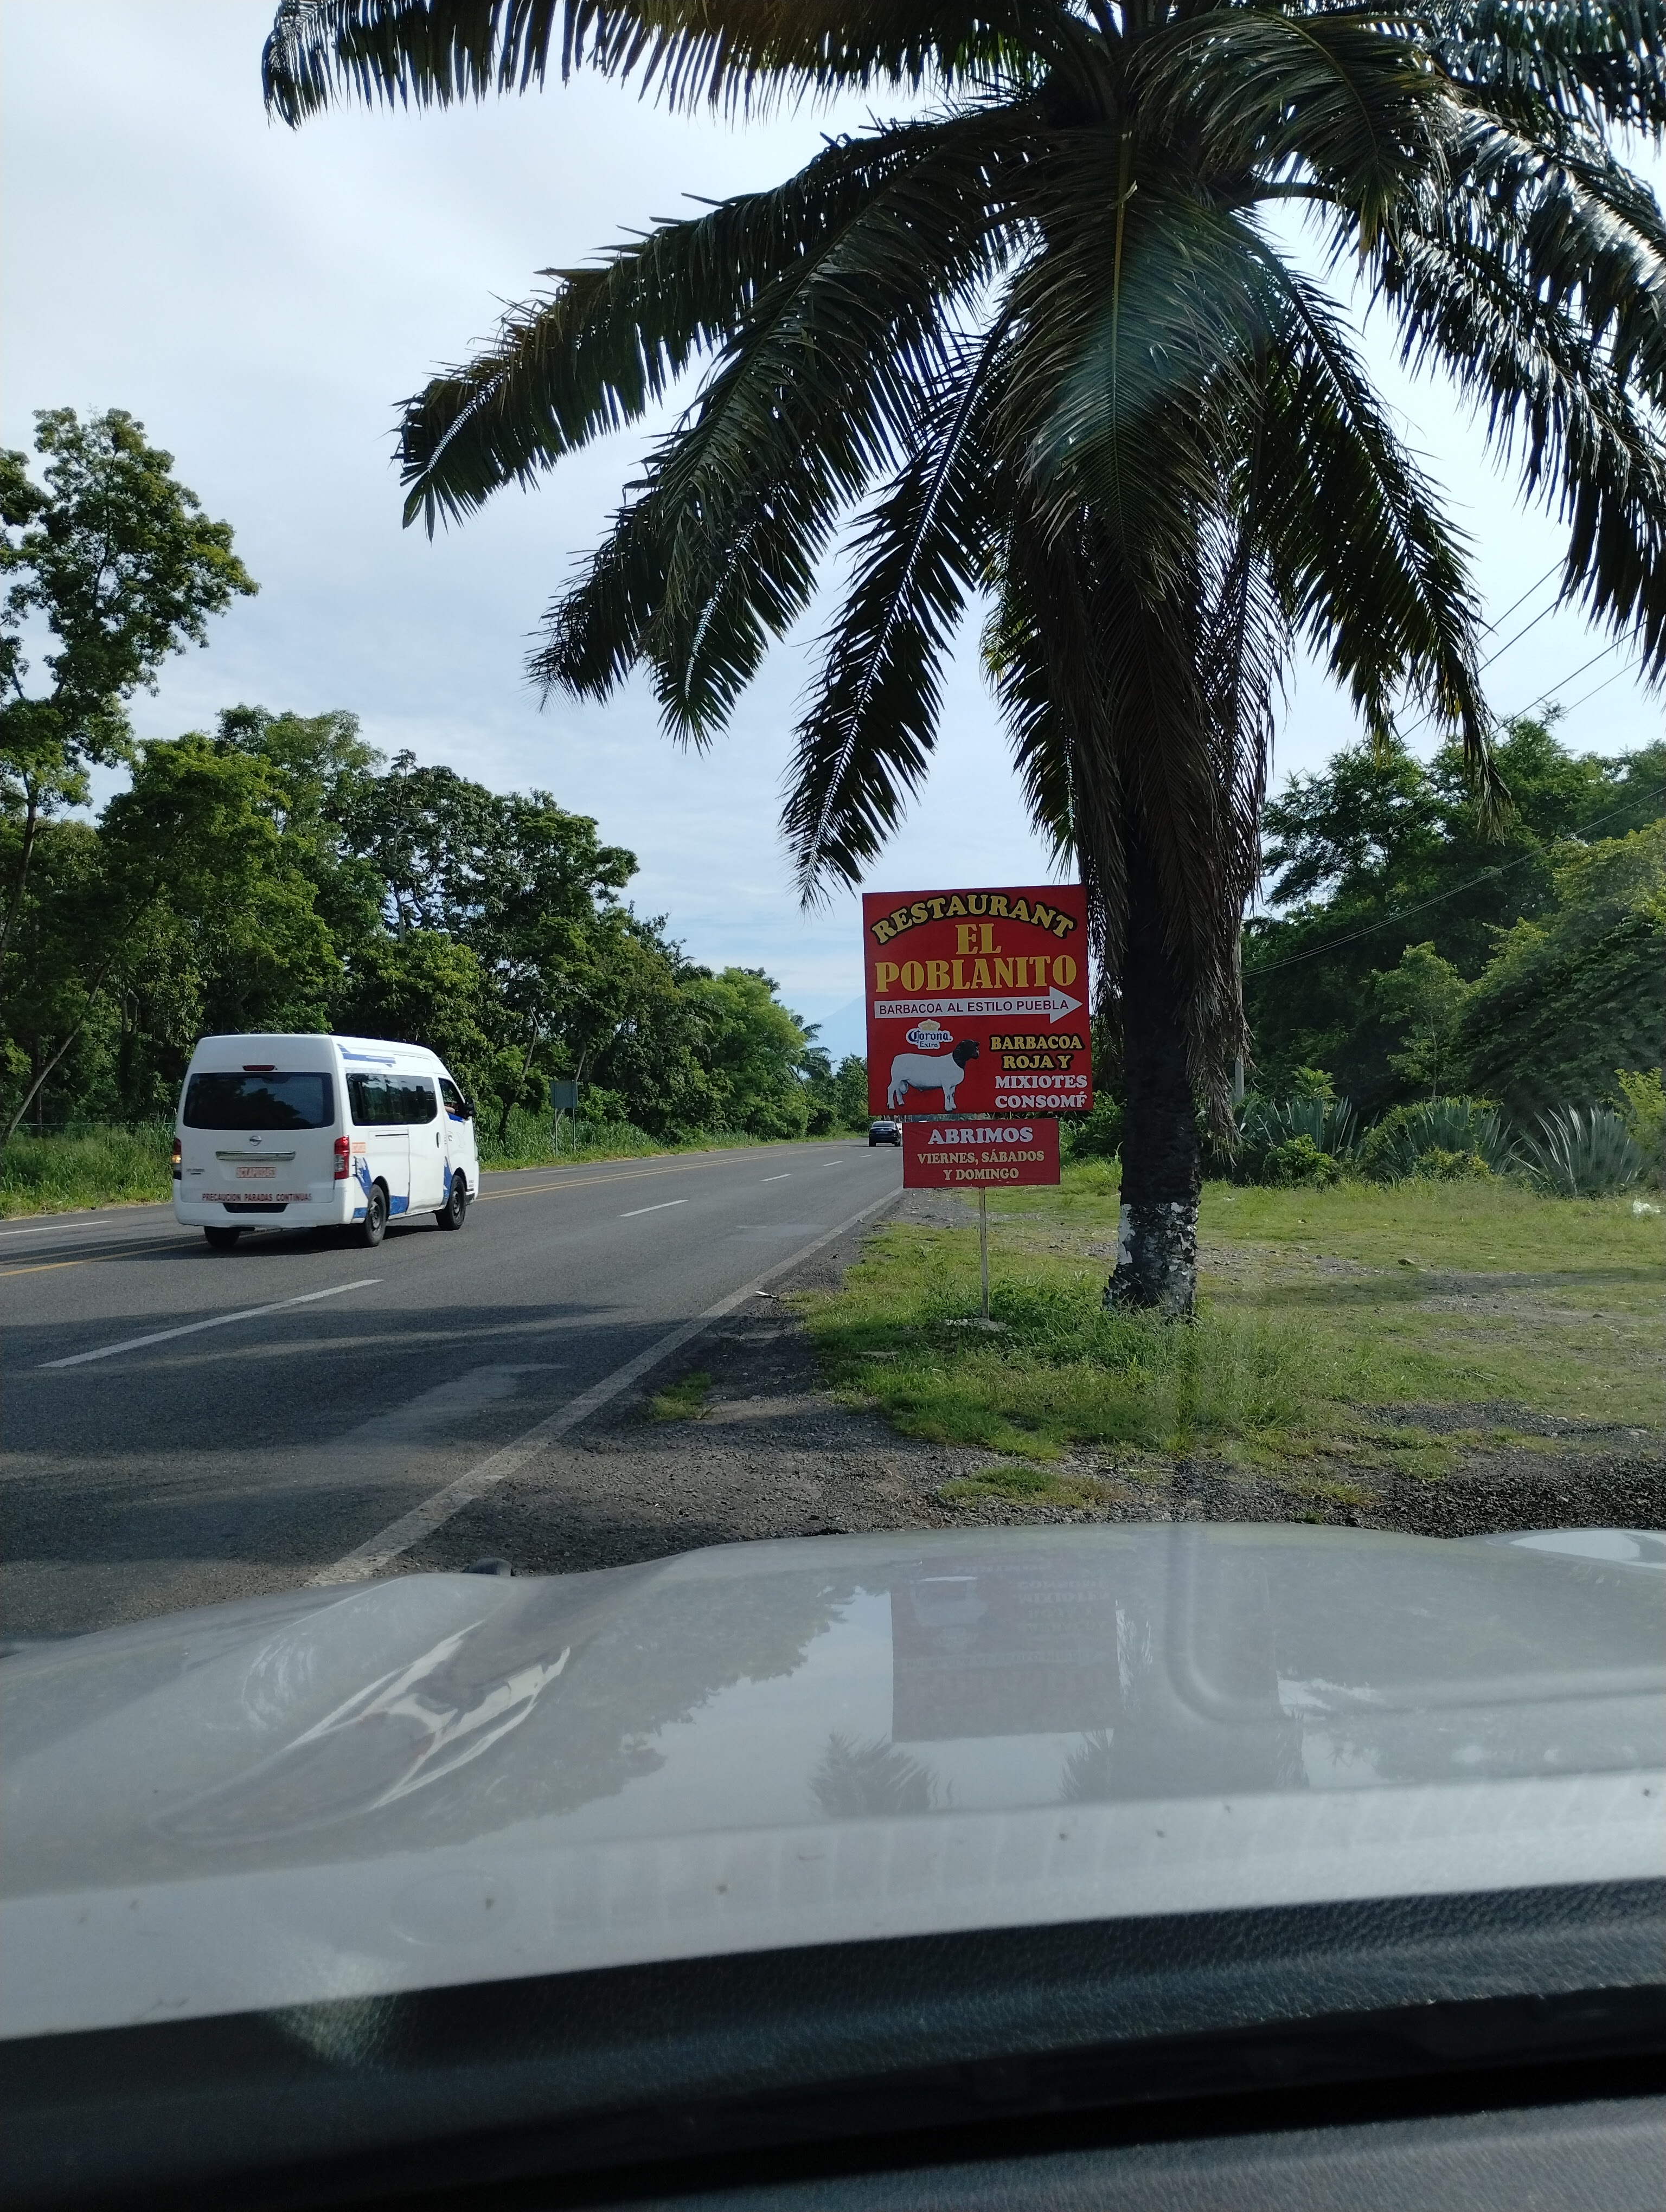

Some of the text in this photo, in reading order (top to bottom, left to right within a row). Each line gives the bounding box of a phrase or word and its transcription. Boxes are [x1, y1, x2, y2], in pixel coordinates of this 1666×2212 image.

[872, 895, 1074, 944] RESTAURANT
[955, 923, 1002, 955] EL
[875, 955, 1077, 993] POBLANITO
[879, 999, 1069, 1015] BARBACOA AL ESTILO PUEBLA
[991, 1036, 1082, 1050] BARBACOA
[1003, 1055, 1072, 1069] ROJA Y
[995, 1075, 1087, 1089] MIXIOTES
[927, 1127, 1033, 1144] ABRIMOS
[917, 1148, 1045, 1165] VIERNES, SÁBADOS
[943, 1168, 1019, 1180] Y DOMINGO
